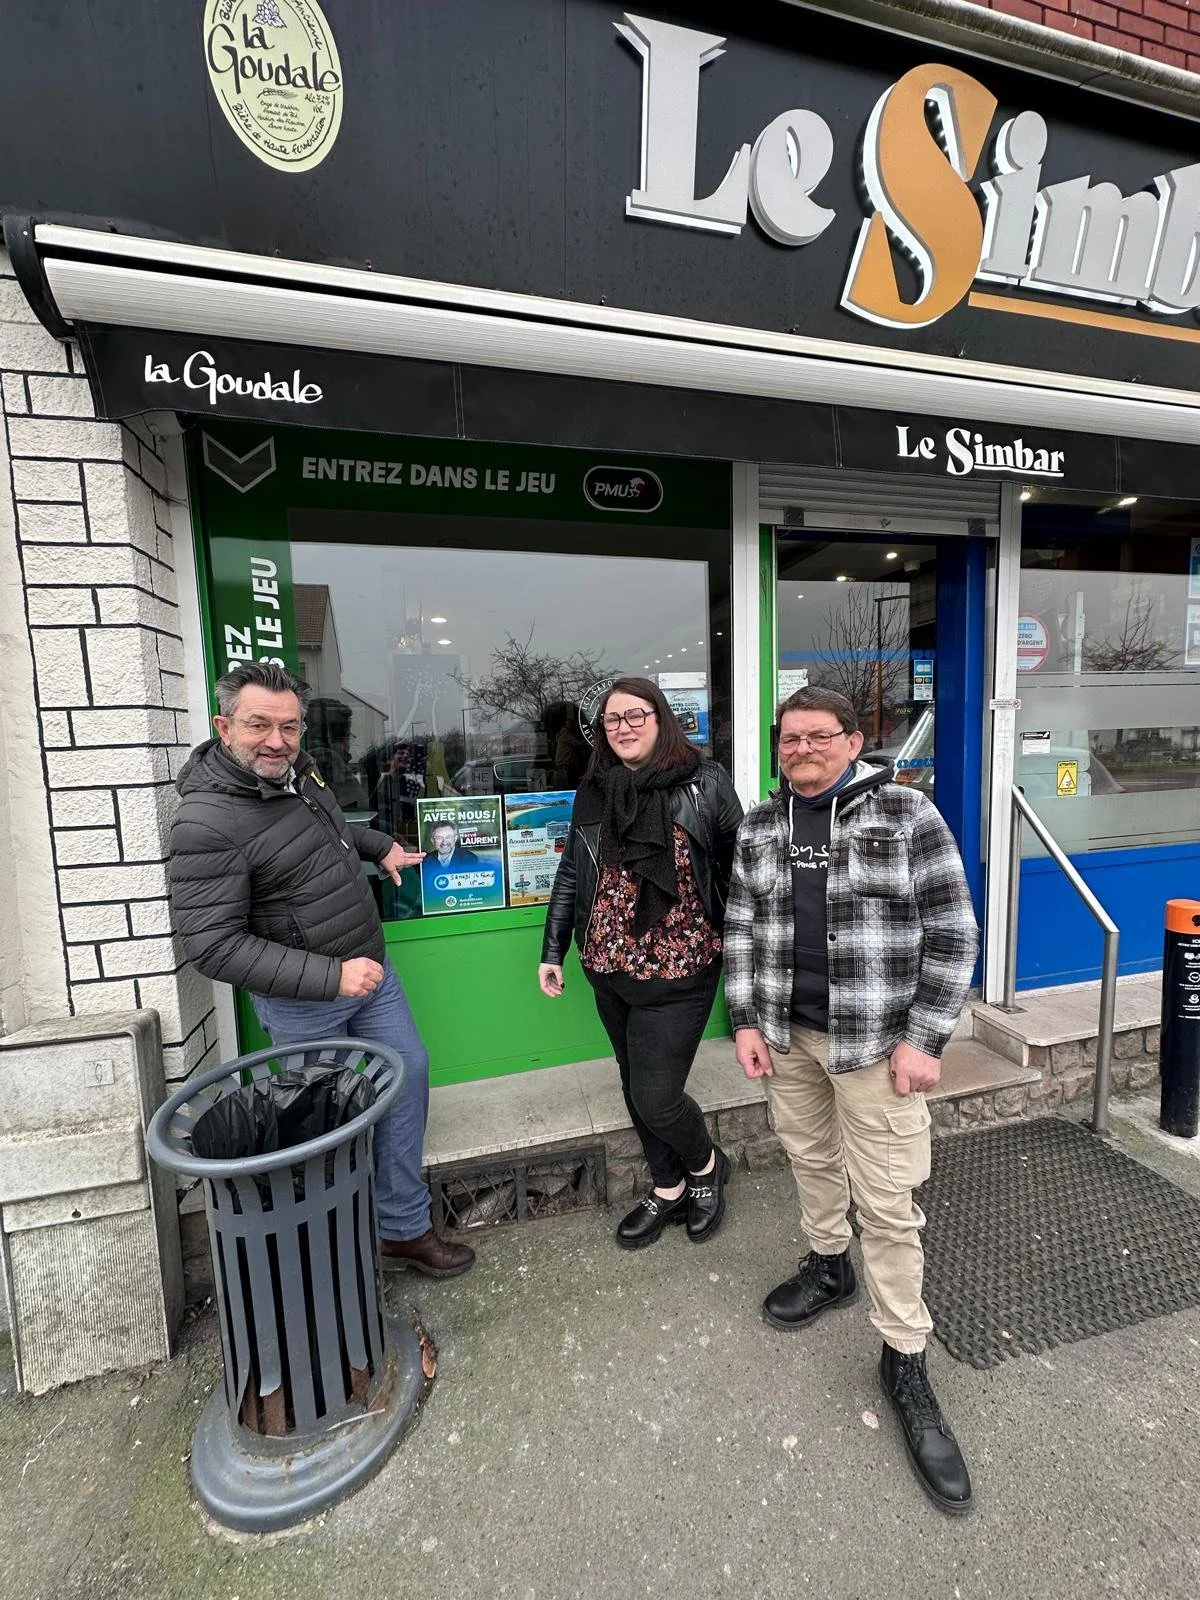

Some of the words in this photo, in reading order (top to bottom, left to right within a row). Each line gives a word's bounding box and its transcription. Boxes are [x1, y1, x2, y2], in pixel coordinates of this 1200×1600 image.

[242, 12, 275, 50] la
[207, 23, 341, 95] Goudale
[612, 12, 836, 246] Le
[144, 354, 181, 384] la
[183, 350, 324, 405] Goudale
[895, 424, 937, 460] Le
[945, 427, 1065, 477] Simbar
[301, 456, 404, 486] ENTREZ
[409, 463, 478, 490] DANS
[484, 469, 510, 491] LE
[515, 472, 557, 494] JEU
[593, 481, 631, 498] PMU
[250, 556, 280, 610] JEU
[255, 615, 283, 649] LE
[592, 680, 616, 695] SAVO
[423, 812, 456, 823] AVEC
[460, 836, 498, 846] LAURENT
